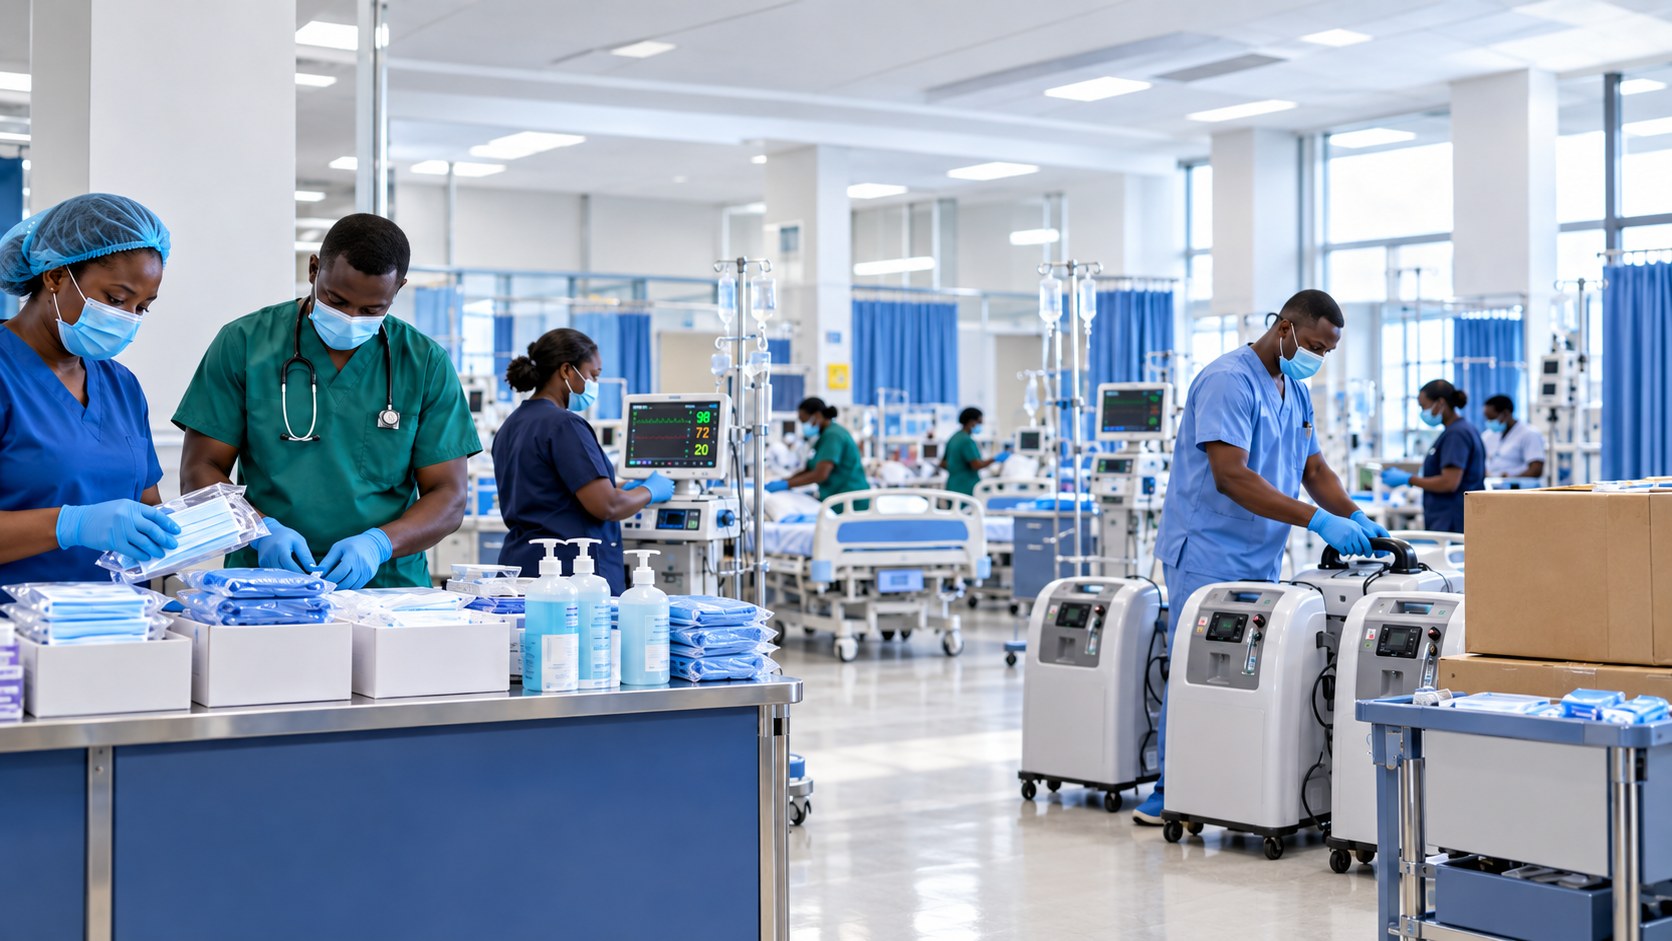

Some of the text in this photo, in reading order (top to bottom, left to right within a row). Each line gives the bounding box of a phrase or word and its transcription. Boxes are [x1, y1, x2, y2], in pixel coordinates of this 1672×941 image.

[696, 411, 711, 424] 98
[695, 426, 710, 439] 72
[694, 443, 709, 456] 20
